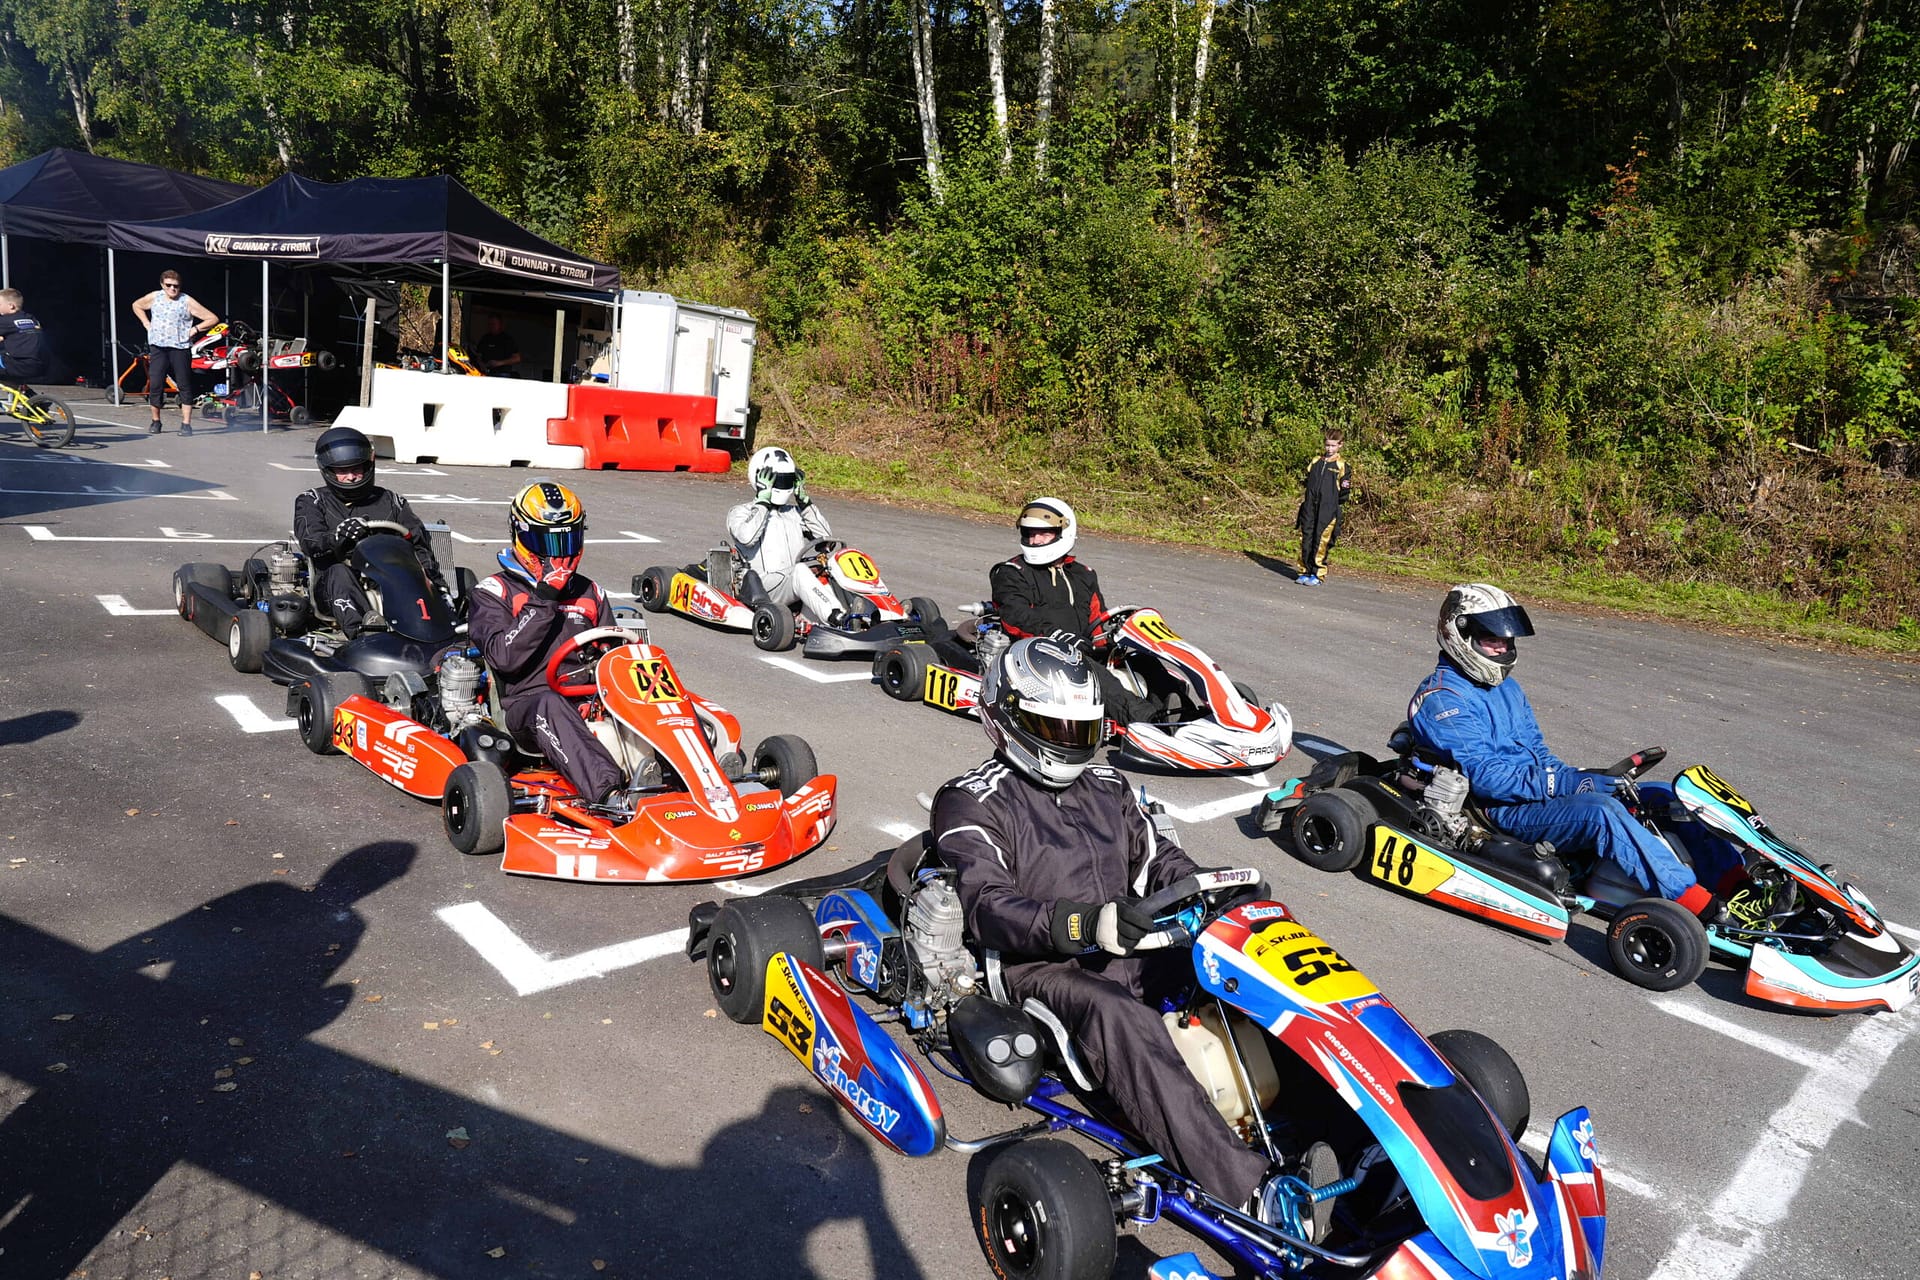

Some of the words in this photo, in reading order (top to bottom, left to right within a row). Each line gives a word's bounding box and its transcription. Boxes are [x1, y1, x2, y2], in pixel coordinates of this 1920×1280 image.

[232, 241, 270, 251] GUNNAR
[270, 242, 278, 251] T.
[511, 256, 549, 272] GUNNAR
[550, 263, 558, 273] T.
[848, 556, 873, 579] 19
[416, 598, 431, 621] 1
[690, 585, 728, 619] birel
[635, 662, 677, 698] 43
[929, 669, 958, 707] 118
[1377, 835, 1417, 886] 48
[1070, 915, 1080, 938] OMP
[1282, 946, 1360, 986] 53
[767, 995, 812, 1057] 53
[1324, 1030, 1395, 1105] energycorse.com
[824, 1052, 900, 1133] Energy
